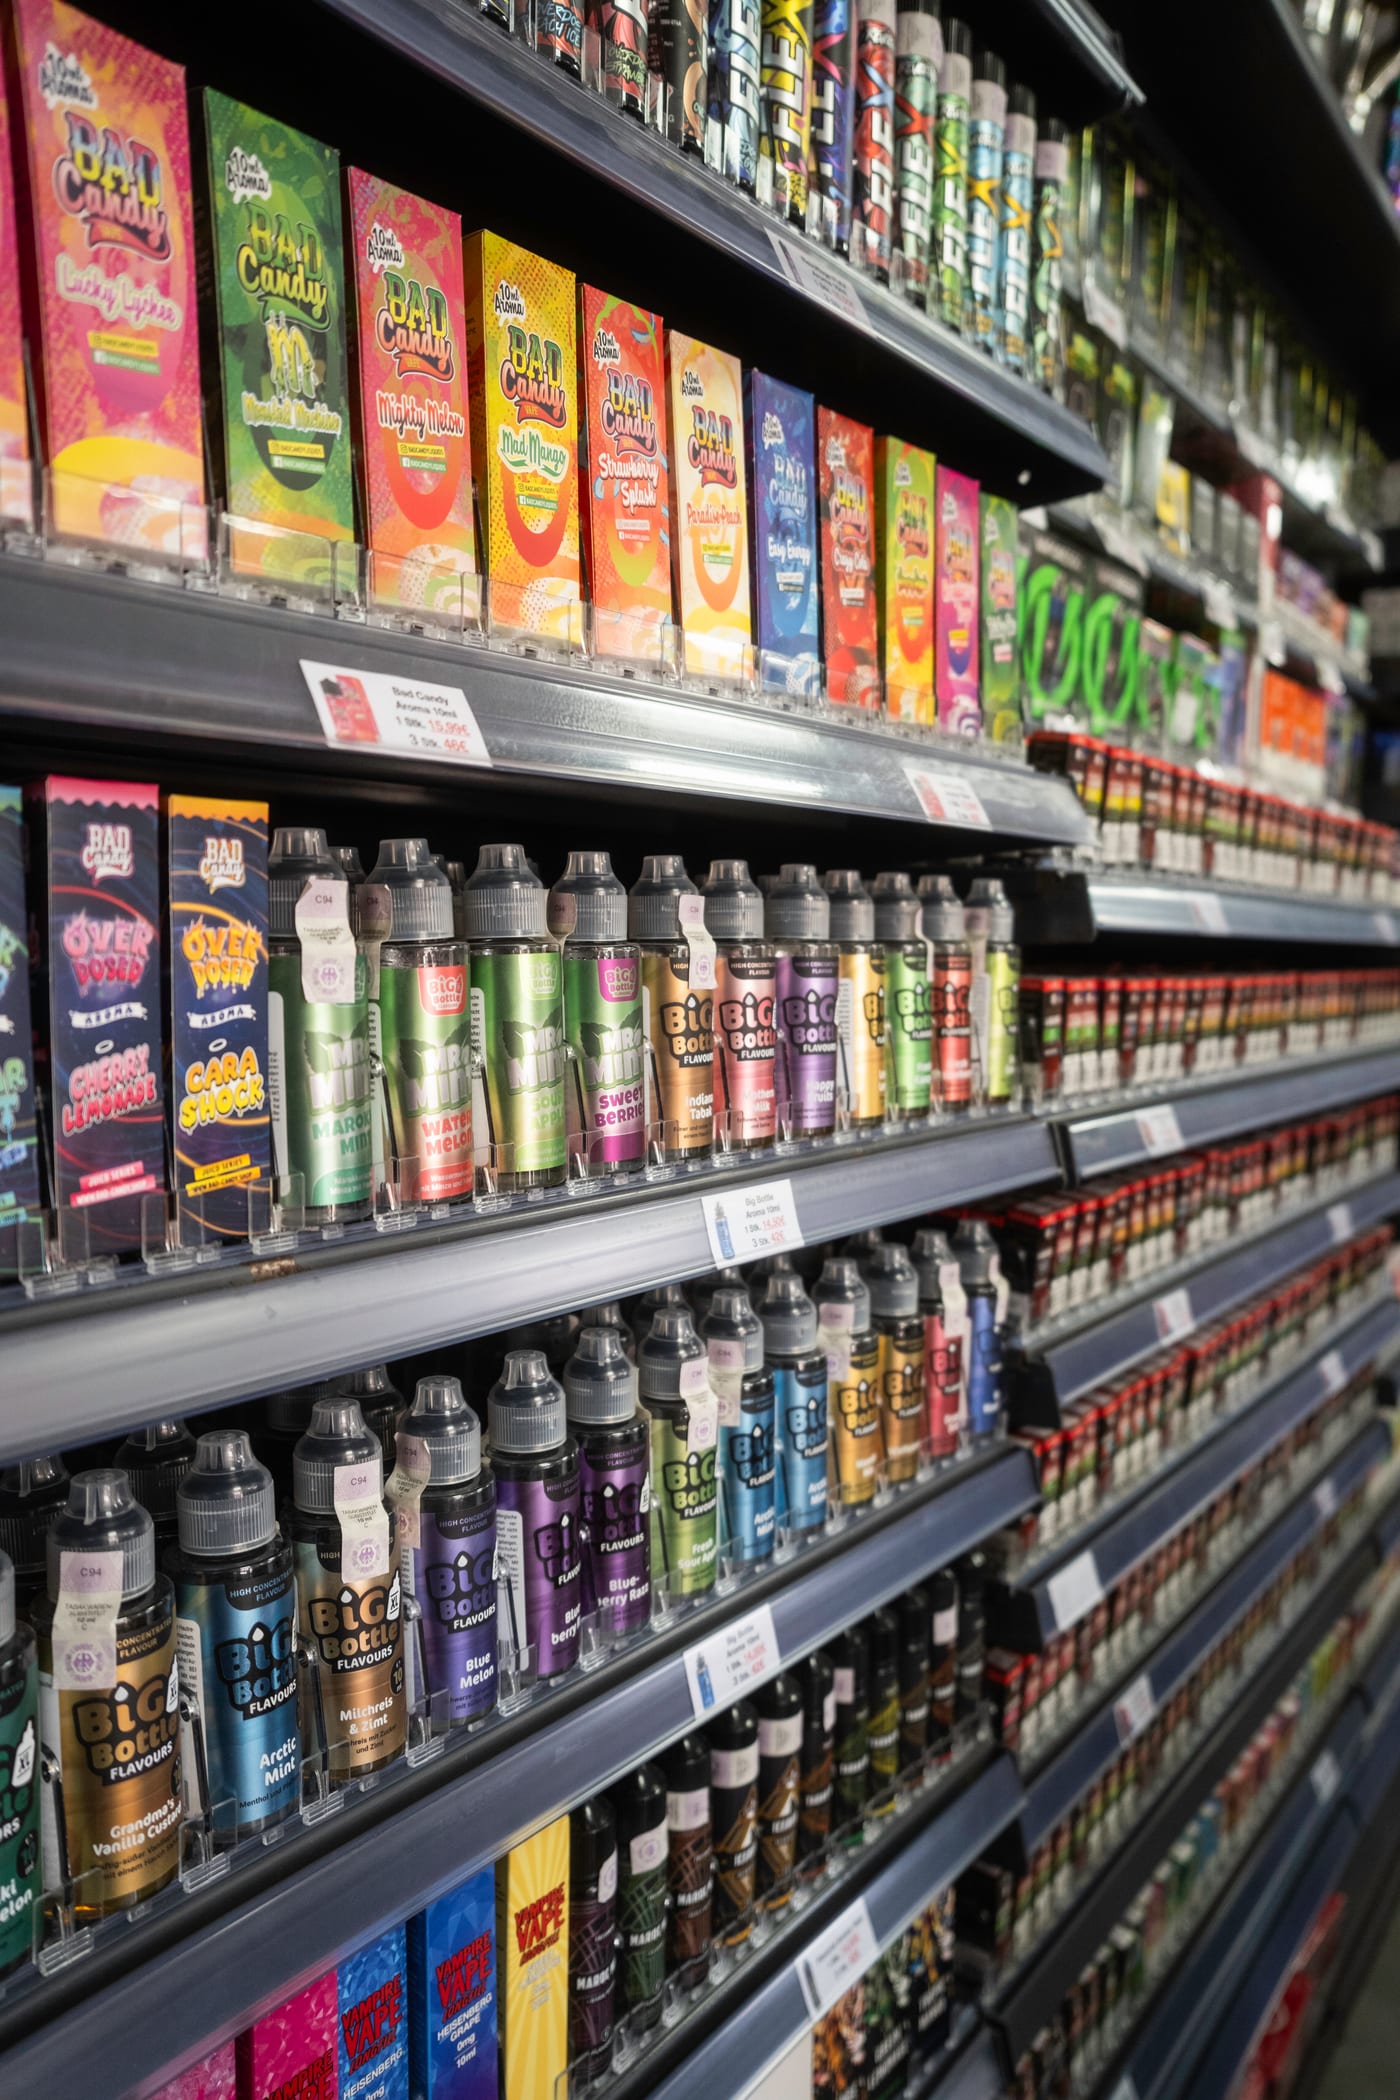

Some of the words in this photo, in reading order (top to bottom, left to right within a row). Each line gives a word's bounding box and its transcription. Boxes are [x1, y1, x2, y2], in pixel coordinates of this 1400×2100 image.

[40, 66, 93, 104] Aroma
[65, 110, 160, 208] BAD
[227, 163, 268, 194] Aroma
[53, 157, 169, 252] Candy
[245, 203, 324, 284] BAD
[367, 240, 403, 263] Aroma
[239, 244, 328, 316] Candy
[500, 283, 510, 299] 10
[384, 272, 448, 339] BAD
[494, 293, 525, 315] Aroma
[378, 309, 453, 372] Candy
[594, 340, 619, 360] Aroma
[508, 325, 562, 388] BAD
[501, 360, 566, 420] Candy
[607, 368, 653, 421] BAD
[681, 379, 703, 396] Aroma
[377, 392, 426, 440] Mighty
[428, 398, 464, 436] Melon
[602, 399, 656, 448] Candy
[692, 405, 733, 456] BAD
[500, 428, 528, 456] Mad
[528, 431, 566, 471] Mango
[688, 435, 735, 484] Candy
[598, 454, 659, 485] Strawberry
[773, 453, 806, 492] BAD
[620, 481, 656, 515] Splash
[769, 479, 808, 517] Candy
[687, 503, 720, 525] Paradise
[392, 686, 414, 699] Bad
[416, 690, 449, 706] Candy
[396, 701, 432, 715] Aroma
[433, 707, 458, 719] 10ml
[409, 734, 418, 746] 3
[87, 823, 131, 853] BAD
[206, 837, 244, 863] BAD
[82, 845, 134, 871] Candy
[200, 856, 245, 880] Candy
[63, 907, 153, 959] OVER
[182, 919, 262, 962] OVER
[72, 954, 147, 991] DOSED
[189, 956, 258, 994] DOSED
[609, 981, 634, 993] Bottle
[84, 1005, 134, 1026] AROMA
[201, 1006, 245, 1026] AROMA
[70, 1043, 150, 1101] CHERRY
[187, 1046, 259, 1093] CARA
[63, 1072, 156, 1134] LEMONADE
[180, 1075, 264, 1132] SHOCK
[685, 1094, 714, 1107] Indian
[112, 1168, 137, 1180] SERIES
[222, 1158, 243, 1170] SERIES
[745, 1198, 756, 1207] Big
[756, 1194, 774, 1204] Bottle
[746, 1208, 766, 1218] Aroma
[766, 1204, 780, 1213] 10ml
[751, 1238, 758, 1248] 3
[607, 1457, 634, 1467] FLAVOUR
[350, 1476, 367, 1486] C94
[461, 1518, 488, 1533] FLAVOUR
[600, 1533, 645, 1553] FLAVOURS
[692, 1537, 713, 1554] Fresh
[80, 1567, 102, 1577] C94
[678, 1553, 701, 1569] Sour
[230, 1587, 252, 1598] HIGH
[256, 1583, 286, 1602] FLAVOUR
[608, 1576, 641, 1592] Blue-
[629, 1581, 650, 1601] Razz
[453, 1602, 497, 1630] FLAVOURS
[120, 1638, 158, 1658] FLAVOUR
[321, 1624, 399, 1660] Bottle
[337, 1645, 393, 1671] FLAVOURS
[466, 1652, 491, 1673] Blue
[459, 1663, 495, 1690] Melon
[250, 1678, 297, 1715] FLAVOURS
[340, 1696, 394, 1722] Milchreis
[349, 1723, 358, 1735] &
[361, 1712, 389, 1733] Zimt
[91, 1711, 179, 1770] Bottle
[259, 1736, 297, 1770] Arctic
[355, 1744, 369, 1755] und
[110, 1740, 174, 1781] FLAVOURS
[264, 1755, 296, 1787] Mint
[239, 1792, 269, 1809] Menthol
[93, 1831, 146, 1857] Vanilla
[146, 1800, 183, 1839] Custard
[110, 1798, 176, 1839] Grandma's
[514, 1881, 566, 1929] VAMPIRE
[515, 1901, 566, 1952] VAPE
[435, 1929, 492, 1980] VAMPIRE
[437, 1949, 493, 2007] VAPE
[341, 1972, 403, 2031] VAMPIRE
[437, 1992, 494, 2040] HEISENBERG
[344, 1990, 404, 2060] VAPE
[449, 2012, 482, 2043] GRAPE
[456, 2032, 476, 2052] 0mg
[344, 2047, 404, 2100] HEISENBERG
[455, 2047, 477, 2069] 10ml
